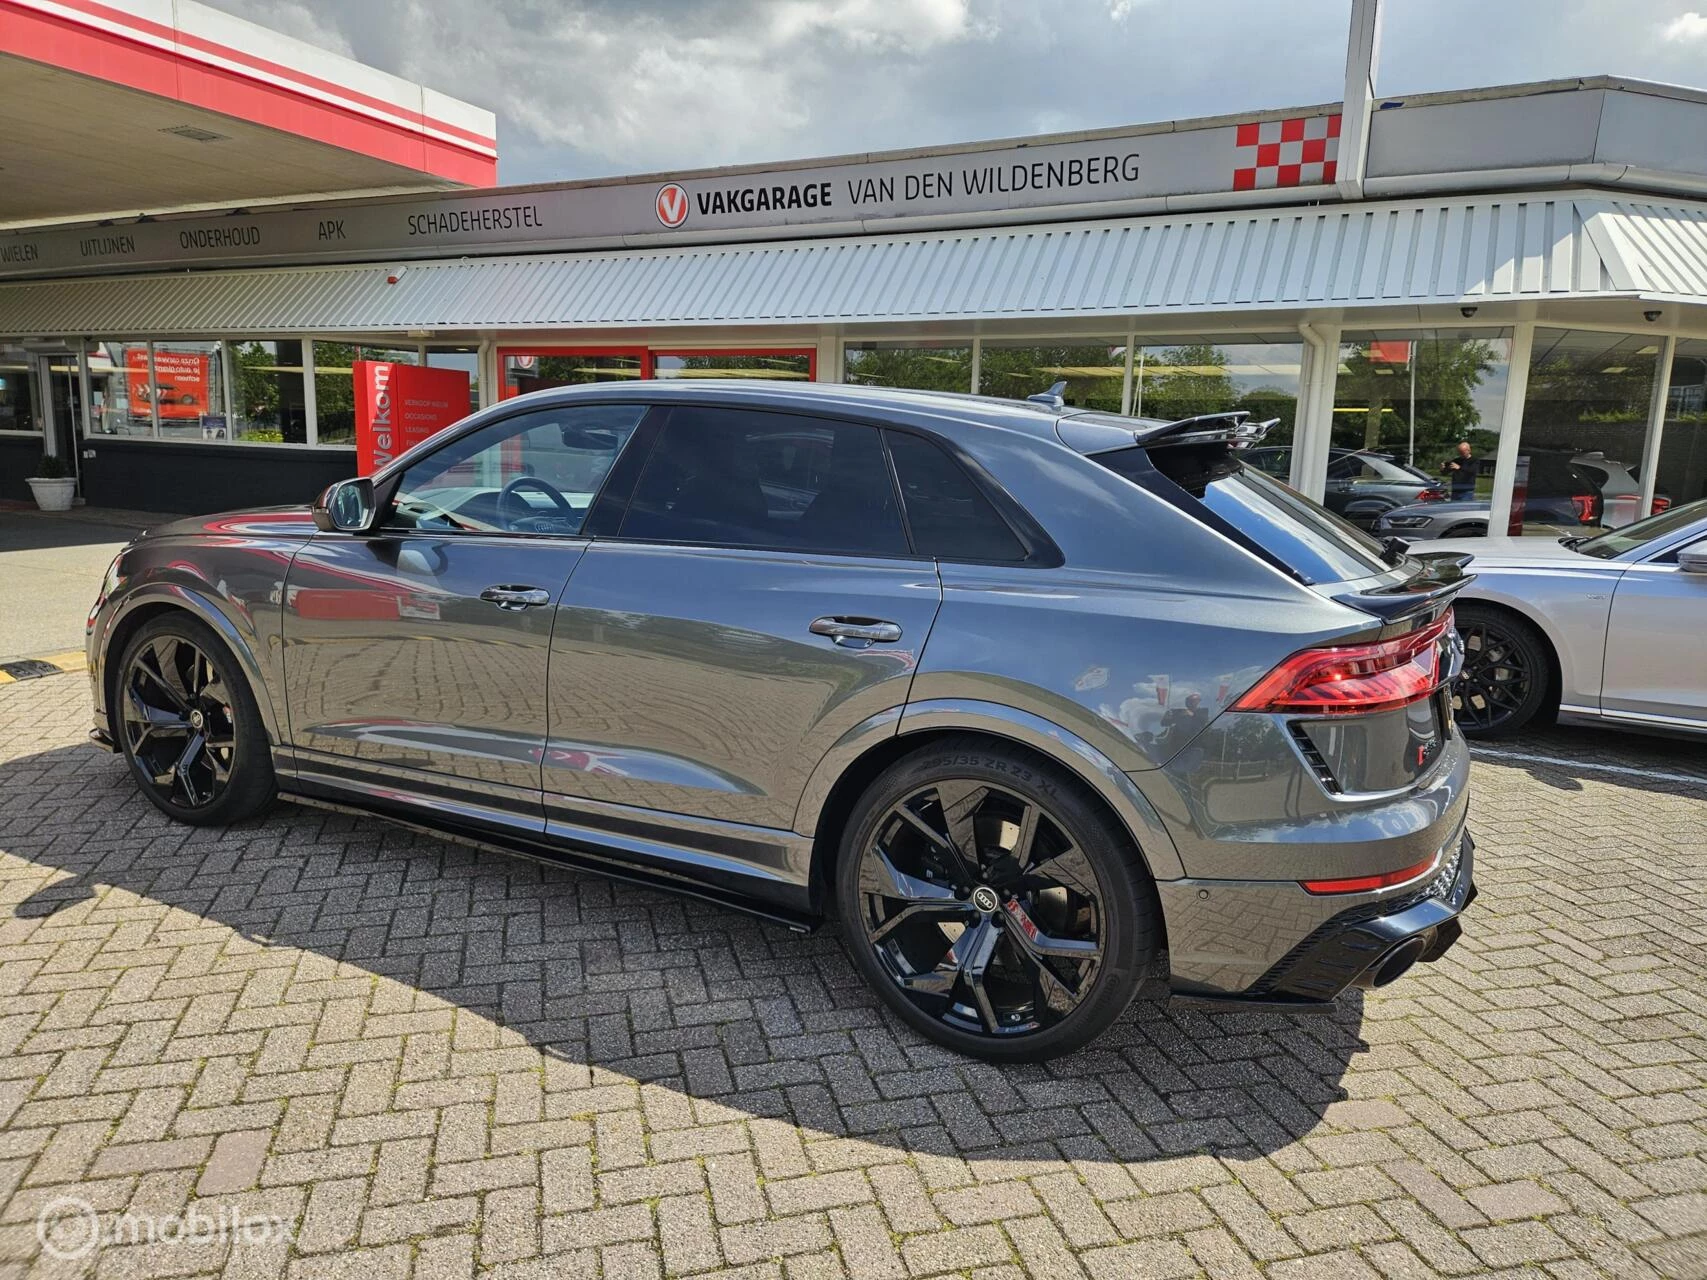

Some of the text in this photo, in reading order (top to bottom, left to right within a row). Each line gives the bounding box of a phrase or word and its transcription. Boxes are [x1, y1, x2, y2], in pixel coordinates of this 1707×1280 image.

[697, 153, 1140, 216] VAKGARAGE VAN DEN WILDENBERG
[318, 220, 347, 241] APK
[408, 205, 543, 236] SCHADEHERSTEL
[80, 235, 136, 257] UITLIJNEN
[180, 226, 261, 249] ONDERHOUD
[0, 244, 39, 262] WIELEN
[372, 365, 394, 467] Welkom
[984, 757, 1007, 772] ZR
[1012, 765, 1033, 782] 23
